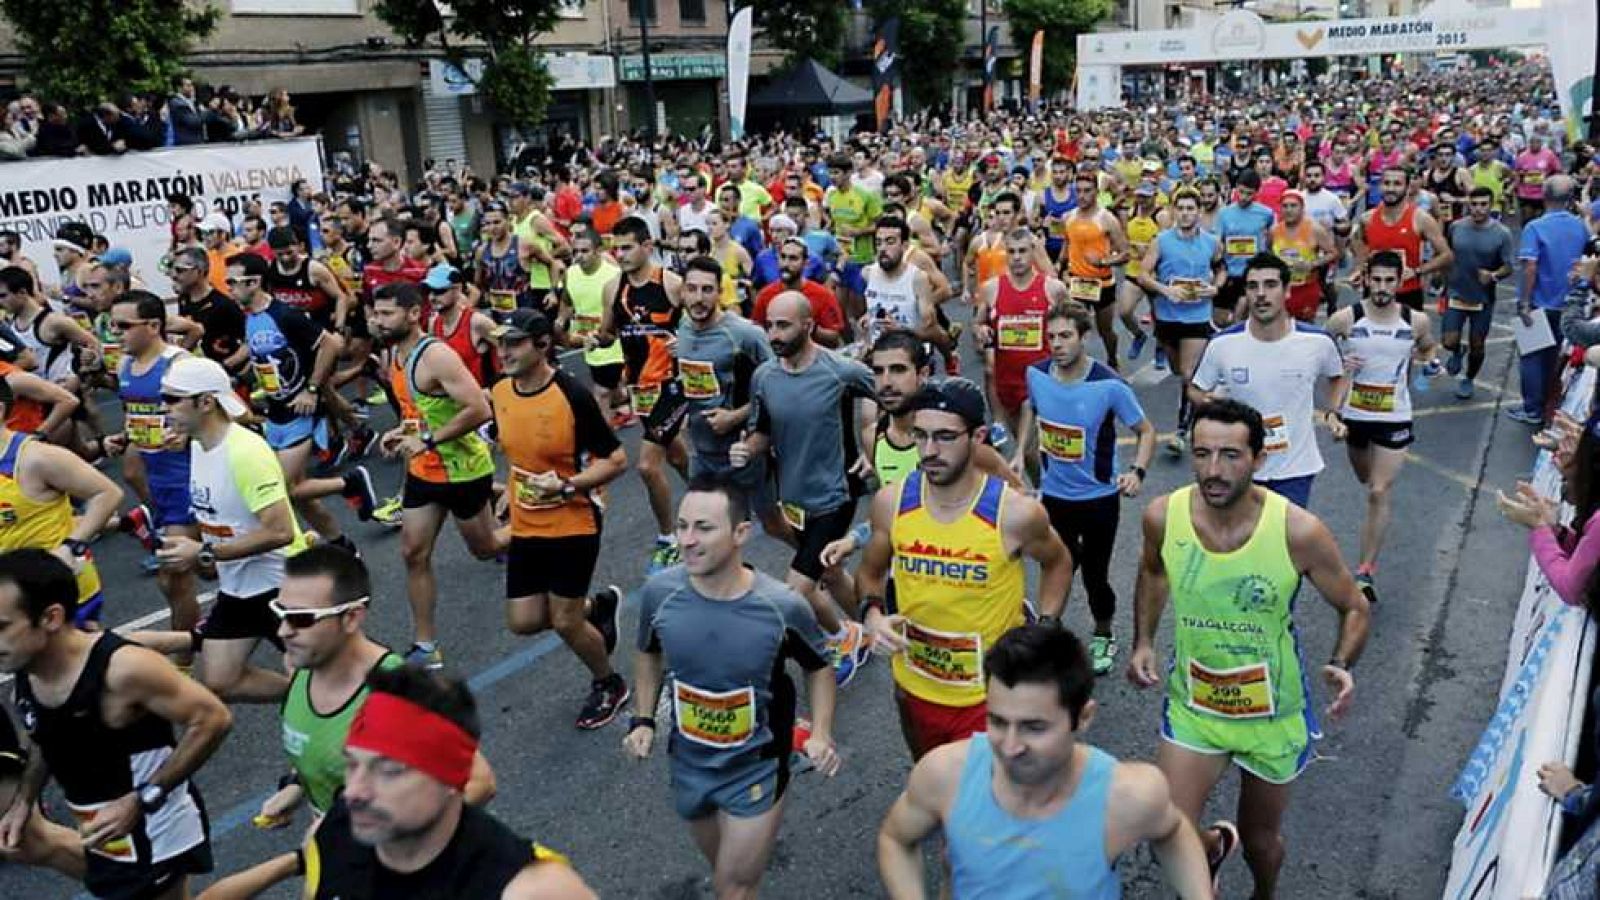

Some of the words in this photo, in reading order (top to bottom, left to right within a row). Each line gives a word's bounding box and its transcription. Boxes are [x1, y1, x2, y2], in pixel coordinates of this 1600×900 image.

[1328, 24, 1366, 38] MEDIO
[1369, 20, 1433, 36] MARATÓN
[1436, 32, 1467, 45] 2015
[0, 186, 78, 218] MEDIO
[86, 169, 205, 208] MARATÓN
[208, 163, 301, 193] VALENCIA
